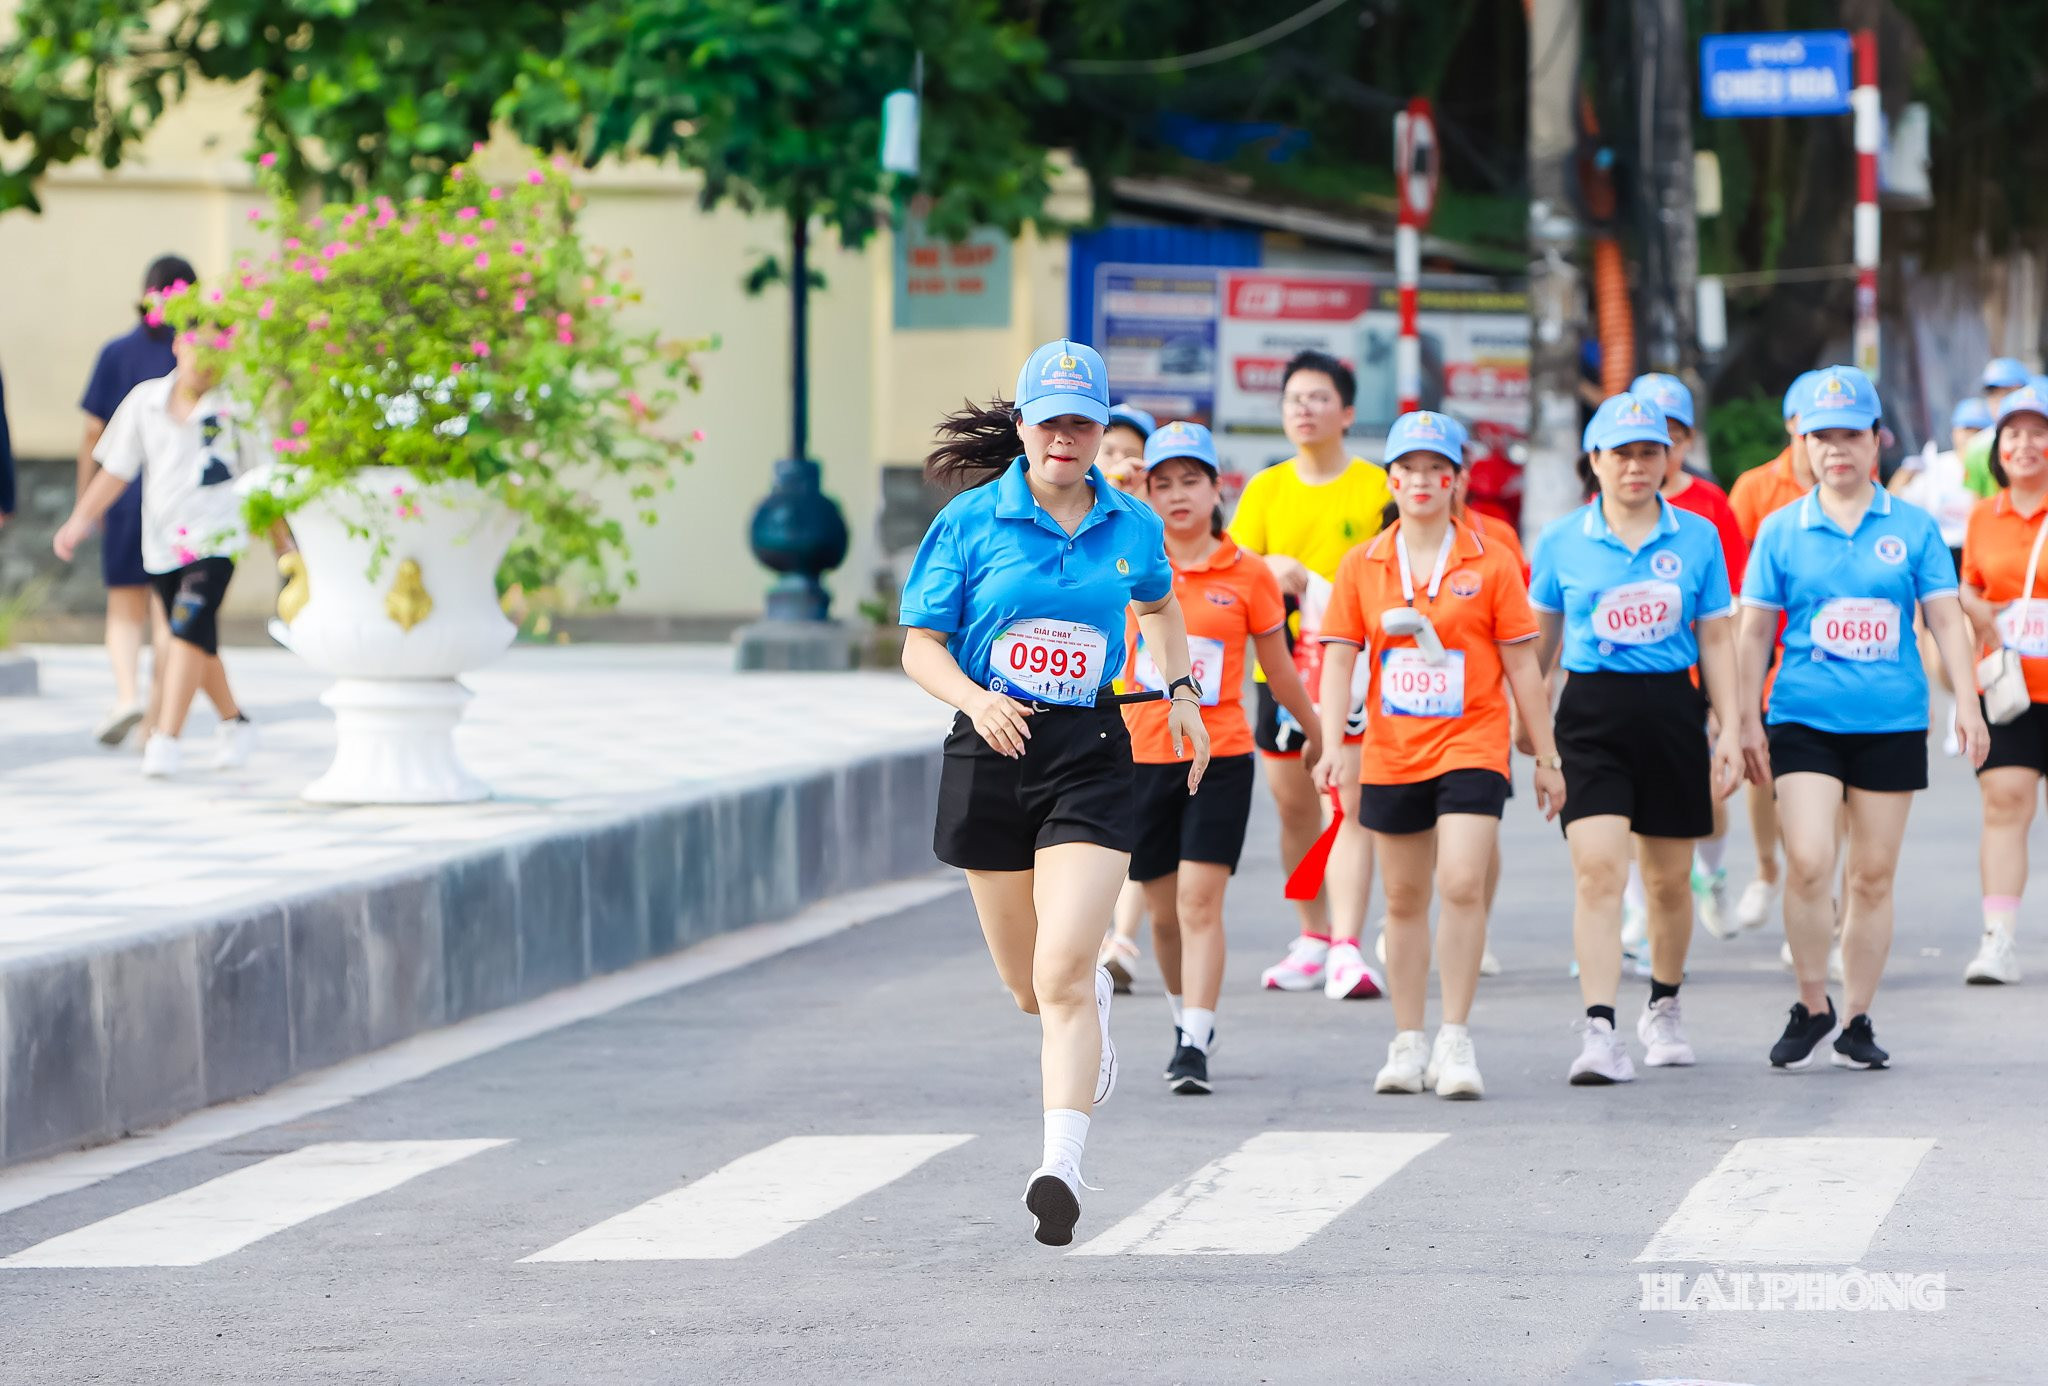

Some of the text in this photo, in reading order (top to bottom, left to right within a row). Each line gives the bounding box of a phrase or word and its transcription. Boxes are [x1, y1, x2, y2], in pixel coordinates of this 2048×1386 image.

[1607, 601, 1669, 631] 0682
[1826, 620, 1888, 642] 0680
[1009, 642, 1087, 679] 0993
[1391, 671, 1448, 694] 1093
